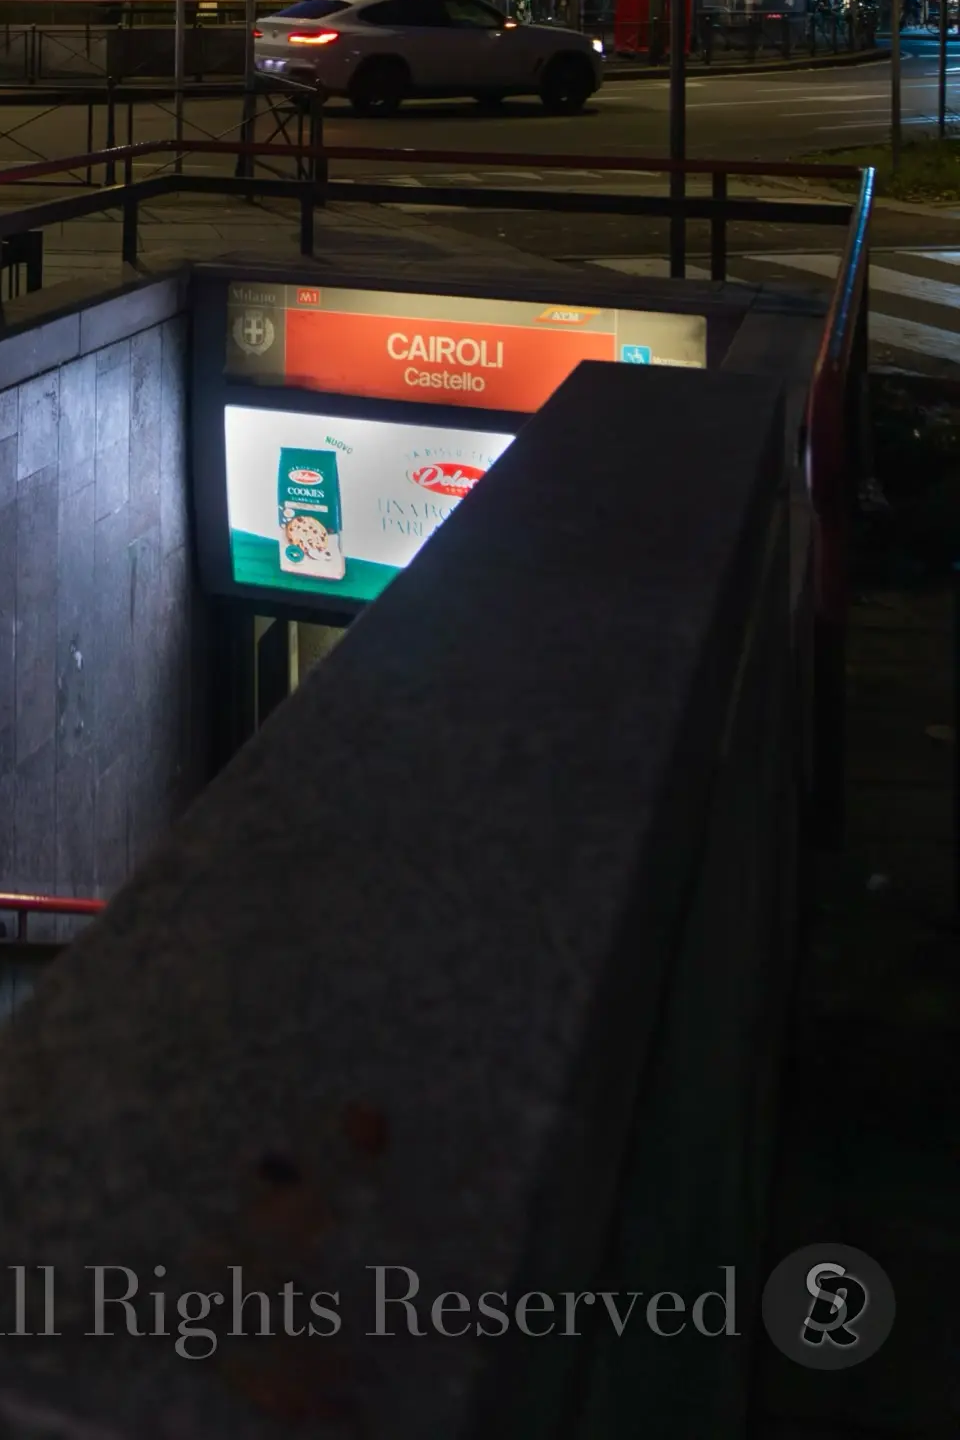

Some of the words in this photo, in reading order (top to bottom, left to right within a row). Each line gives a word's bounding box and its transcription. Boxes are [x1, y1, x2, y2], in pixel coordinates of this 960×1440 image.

[232, 287, 276, 303] Milano
[300, 291, 318, 303] M1
[386, 332, 504, 368] CAIROLI
[404, 366, 486, 392] Castello
[325, 436, 353, 454] NUOVO
[287, 487, 325, 498] COOKIES
